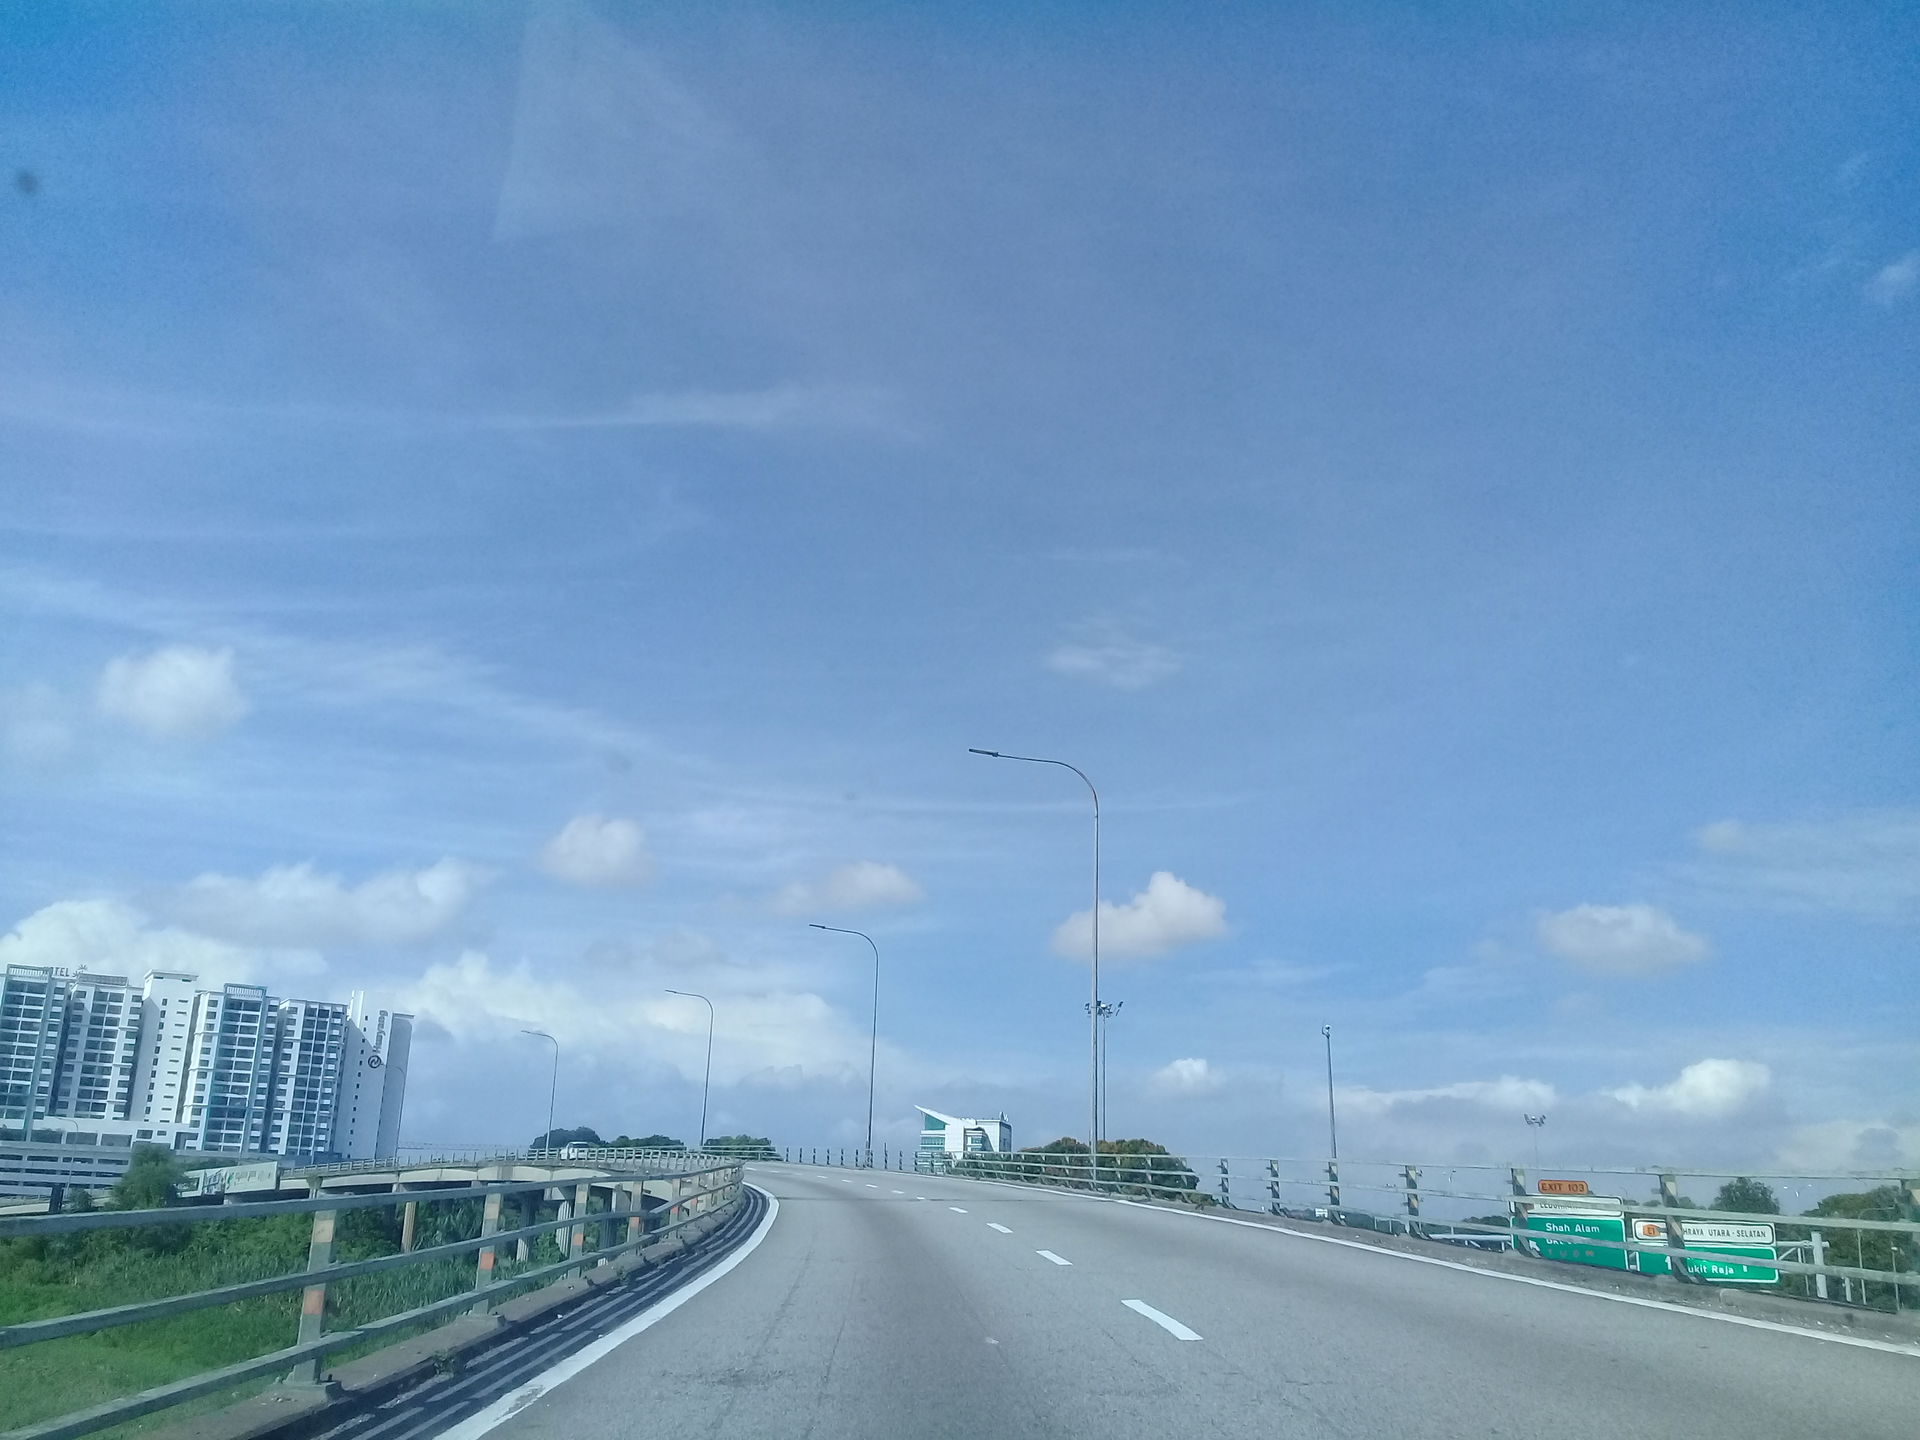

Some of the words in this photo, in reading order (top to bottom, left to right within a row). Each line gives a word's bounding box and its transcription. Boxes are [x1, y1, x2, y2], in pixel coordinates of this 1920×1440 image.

[1541, 1182, 1563, 1192] EXIT
[1568, 1183, 1585, 1192] 103
[1545, 1222, 1570, 1232] Shah
[1575, 1223, 1600, 1233] Alam
[1683, 1227, 1704, 1236] HRAYA
[1708, 1228, 1730, 1237] UTARA
[1736, 1229, 1766, 1238] SELATAN
[1687, 1264, 1707, 1274] ukit
[1711, 1265, 1735, 1275] Raja
